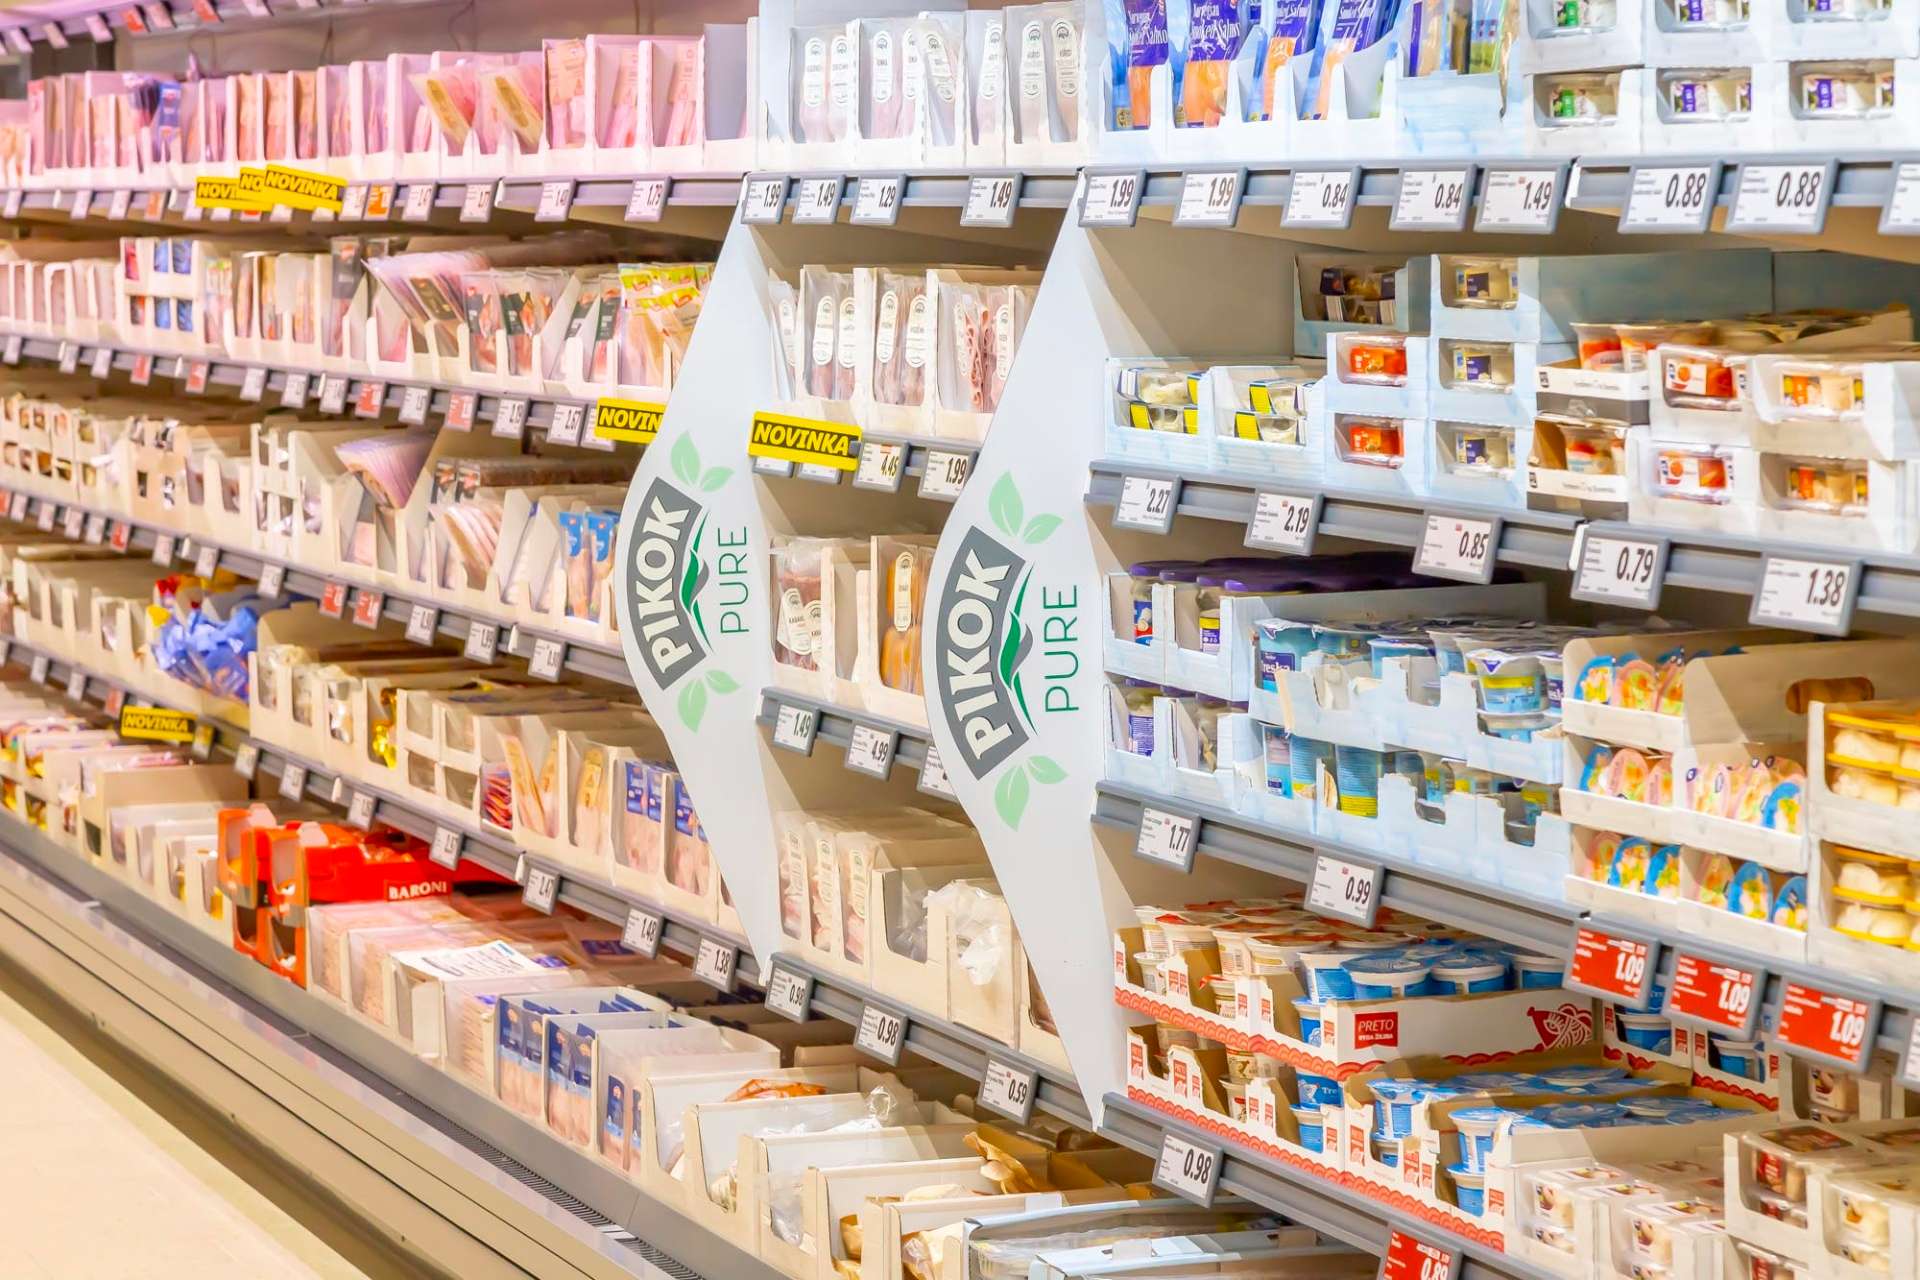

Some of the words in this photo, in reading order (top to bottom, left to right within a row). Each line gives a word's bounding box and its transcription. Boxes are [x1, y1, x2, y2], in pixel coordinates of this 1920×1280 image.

[198, 183, 237, 199] NOVI
[266, 171, 338, 199] NOVINKA
[763, 184, 782, 208] 1.99
[816, 183, 836, 208] 1.49
[878, 186, 897, 208] 1.29
[990, 182, 1013, 209] 1.49
[1110, 179, 1135, 208] 1.99
[1207, 177, 1234, 208] 1.99
[1322, 183, 1349, 209] 0.84
[1434, 183, 1463, 209] 0.84
[1523, 181, 1552, 210] 1.49
[1665, 173, 1707, 208] 0.88
[1776, 171, 1821, 207] 0.88
[599, 406, 664, 432] NOVIN
[753, 422, 850, 457] NOVINKA
[945, 457, 967, 485] 1.99
[1147, 488, 1170, 513] 2.27
[1284, 505, 1309, 533] 2.19
[1458, 531, 1489, 560] 0.85
[1616, 546, 1654, 583] 0.79
[636, 495, 694, 674] PIKOK
[717, 526, 750, 634] PURE
[1806, 568, 1846, 607] 1.38
[947, 549, 1014, 760] PIKOK
[1042, 585, 1080, 713] PURE
[793, 711, 813, 738] 1.49
[871, 742, 889, 762] 4.99
[1168, 824, 1191, 852] 1.77
[388, 881, 447, 899] BARONI
[1345, 876, 1371, 905] 0.99
[714, 948, 731, 975] 1.38
[1615, 952, 1644, 984] 1.09
[1719, 979, 1750, 1012] 1.09
[877, 1016, 899, 1046] 0.98
[1358, 1019, 1394, 1032] PRETO
[1830, 1010, 1865, 1047] 1.09
[1008, 1078, 1028, 1105] 0.59
[1183, 1148, 1212, 1184] 0.98
[1421, 1257, 1448, 1280] 0.89
